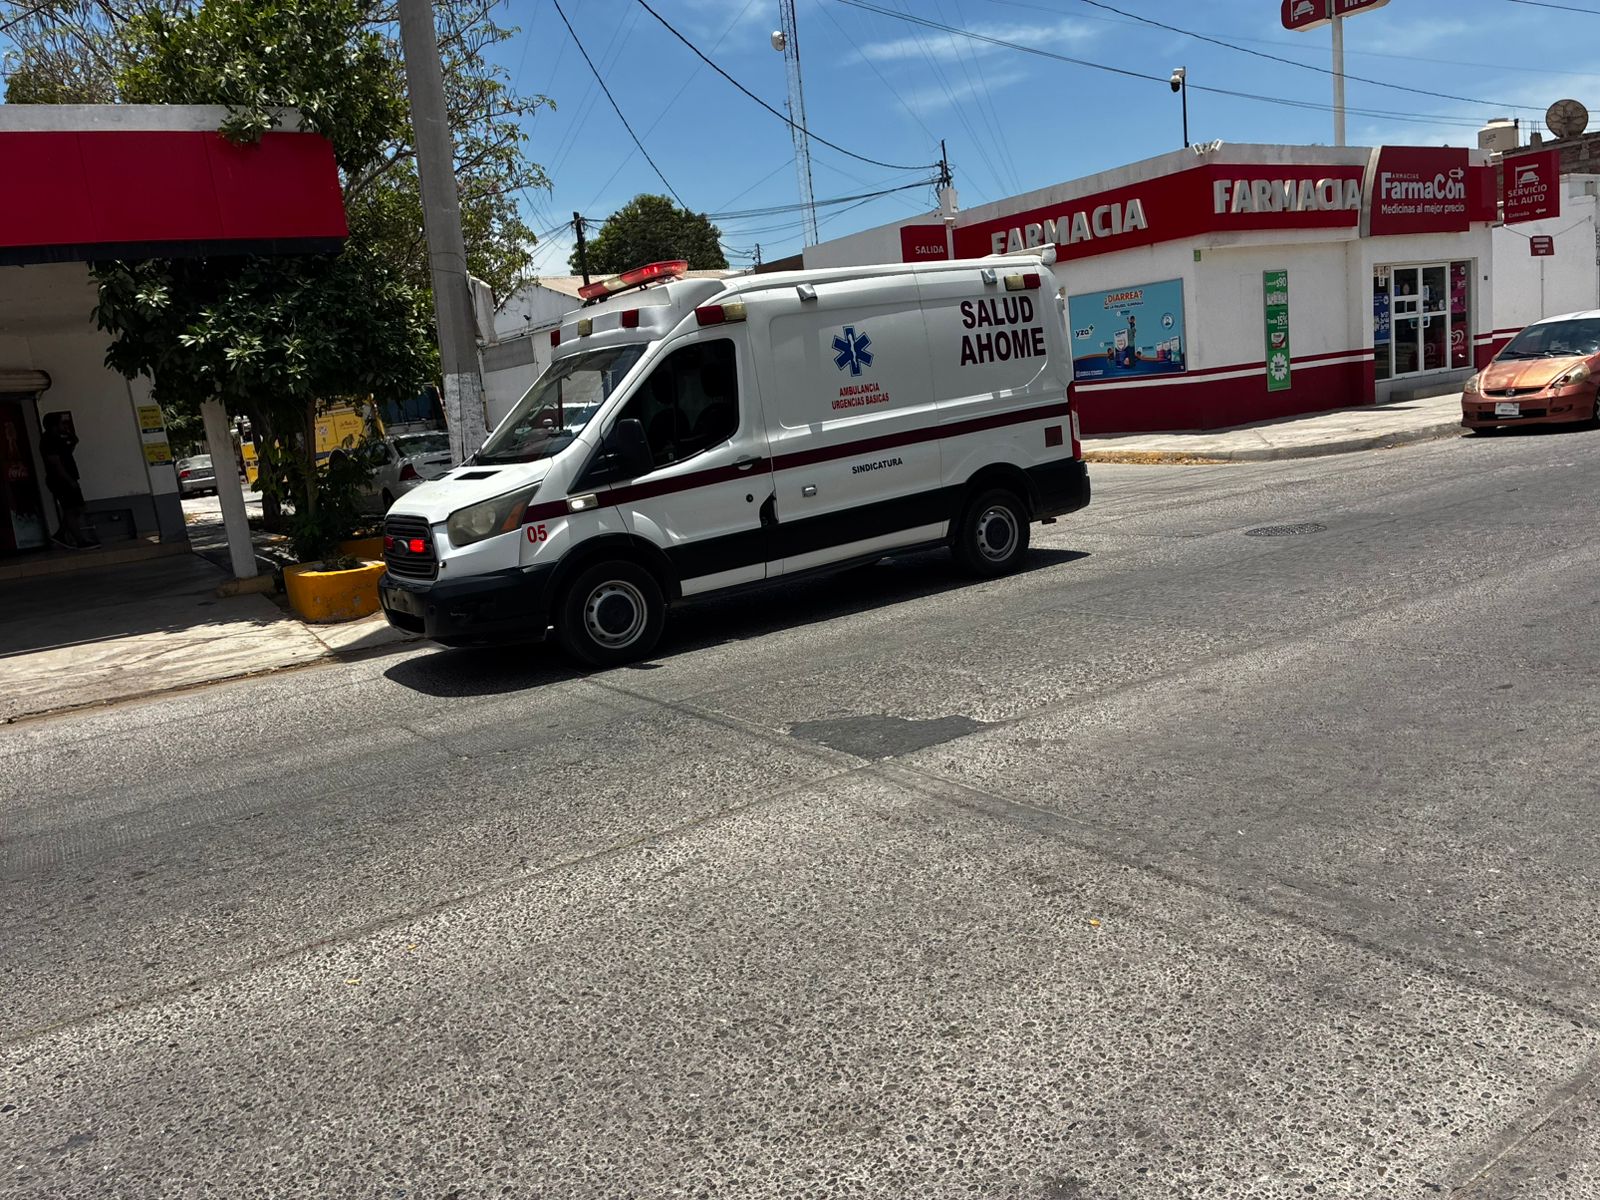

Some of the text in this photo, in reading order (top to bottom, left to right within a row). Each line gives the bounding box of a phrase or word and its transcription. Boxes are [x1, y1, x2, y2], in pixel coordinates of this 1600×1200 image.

[1213, 178, 1361, 214] FARMACIA
[1507, 184, 1547, 198] SERVICIO
[1381, 202, 1465, 214] Medicinas al mejor precio
[1507, 193, 1545, 207] AL AUTO
[991, 198, 1148, 254] FARMACIA
[914, 245, 945, 255] SALIDA
[1104, 290, 1143, 306] ¿DIARREA?
[960, 295, 1034, 329] SALUD
[960, 327, 1046, 366] AHOME
[839, 382, 880, 397] AMBULANCIA
[832, 392, 890, 410] URGENCIAS BASICAS
[852, 457, 903, 474] SINDICATURA
[526, 524, 548, 543] 05
